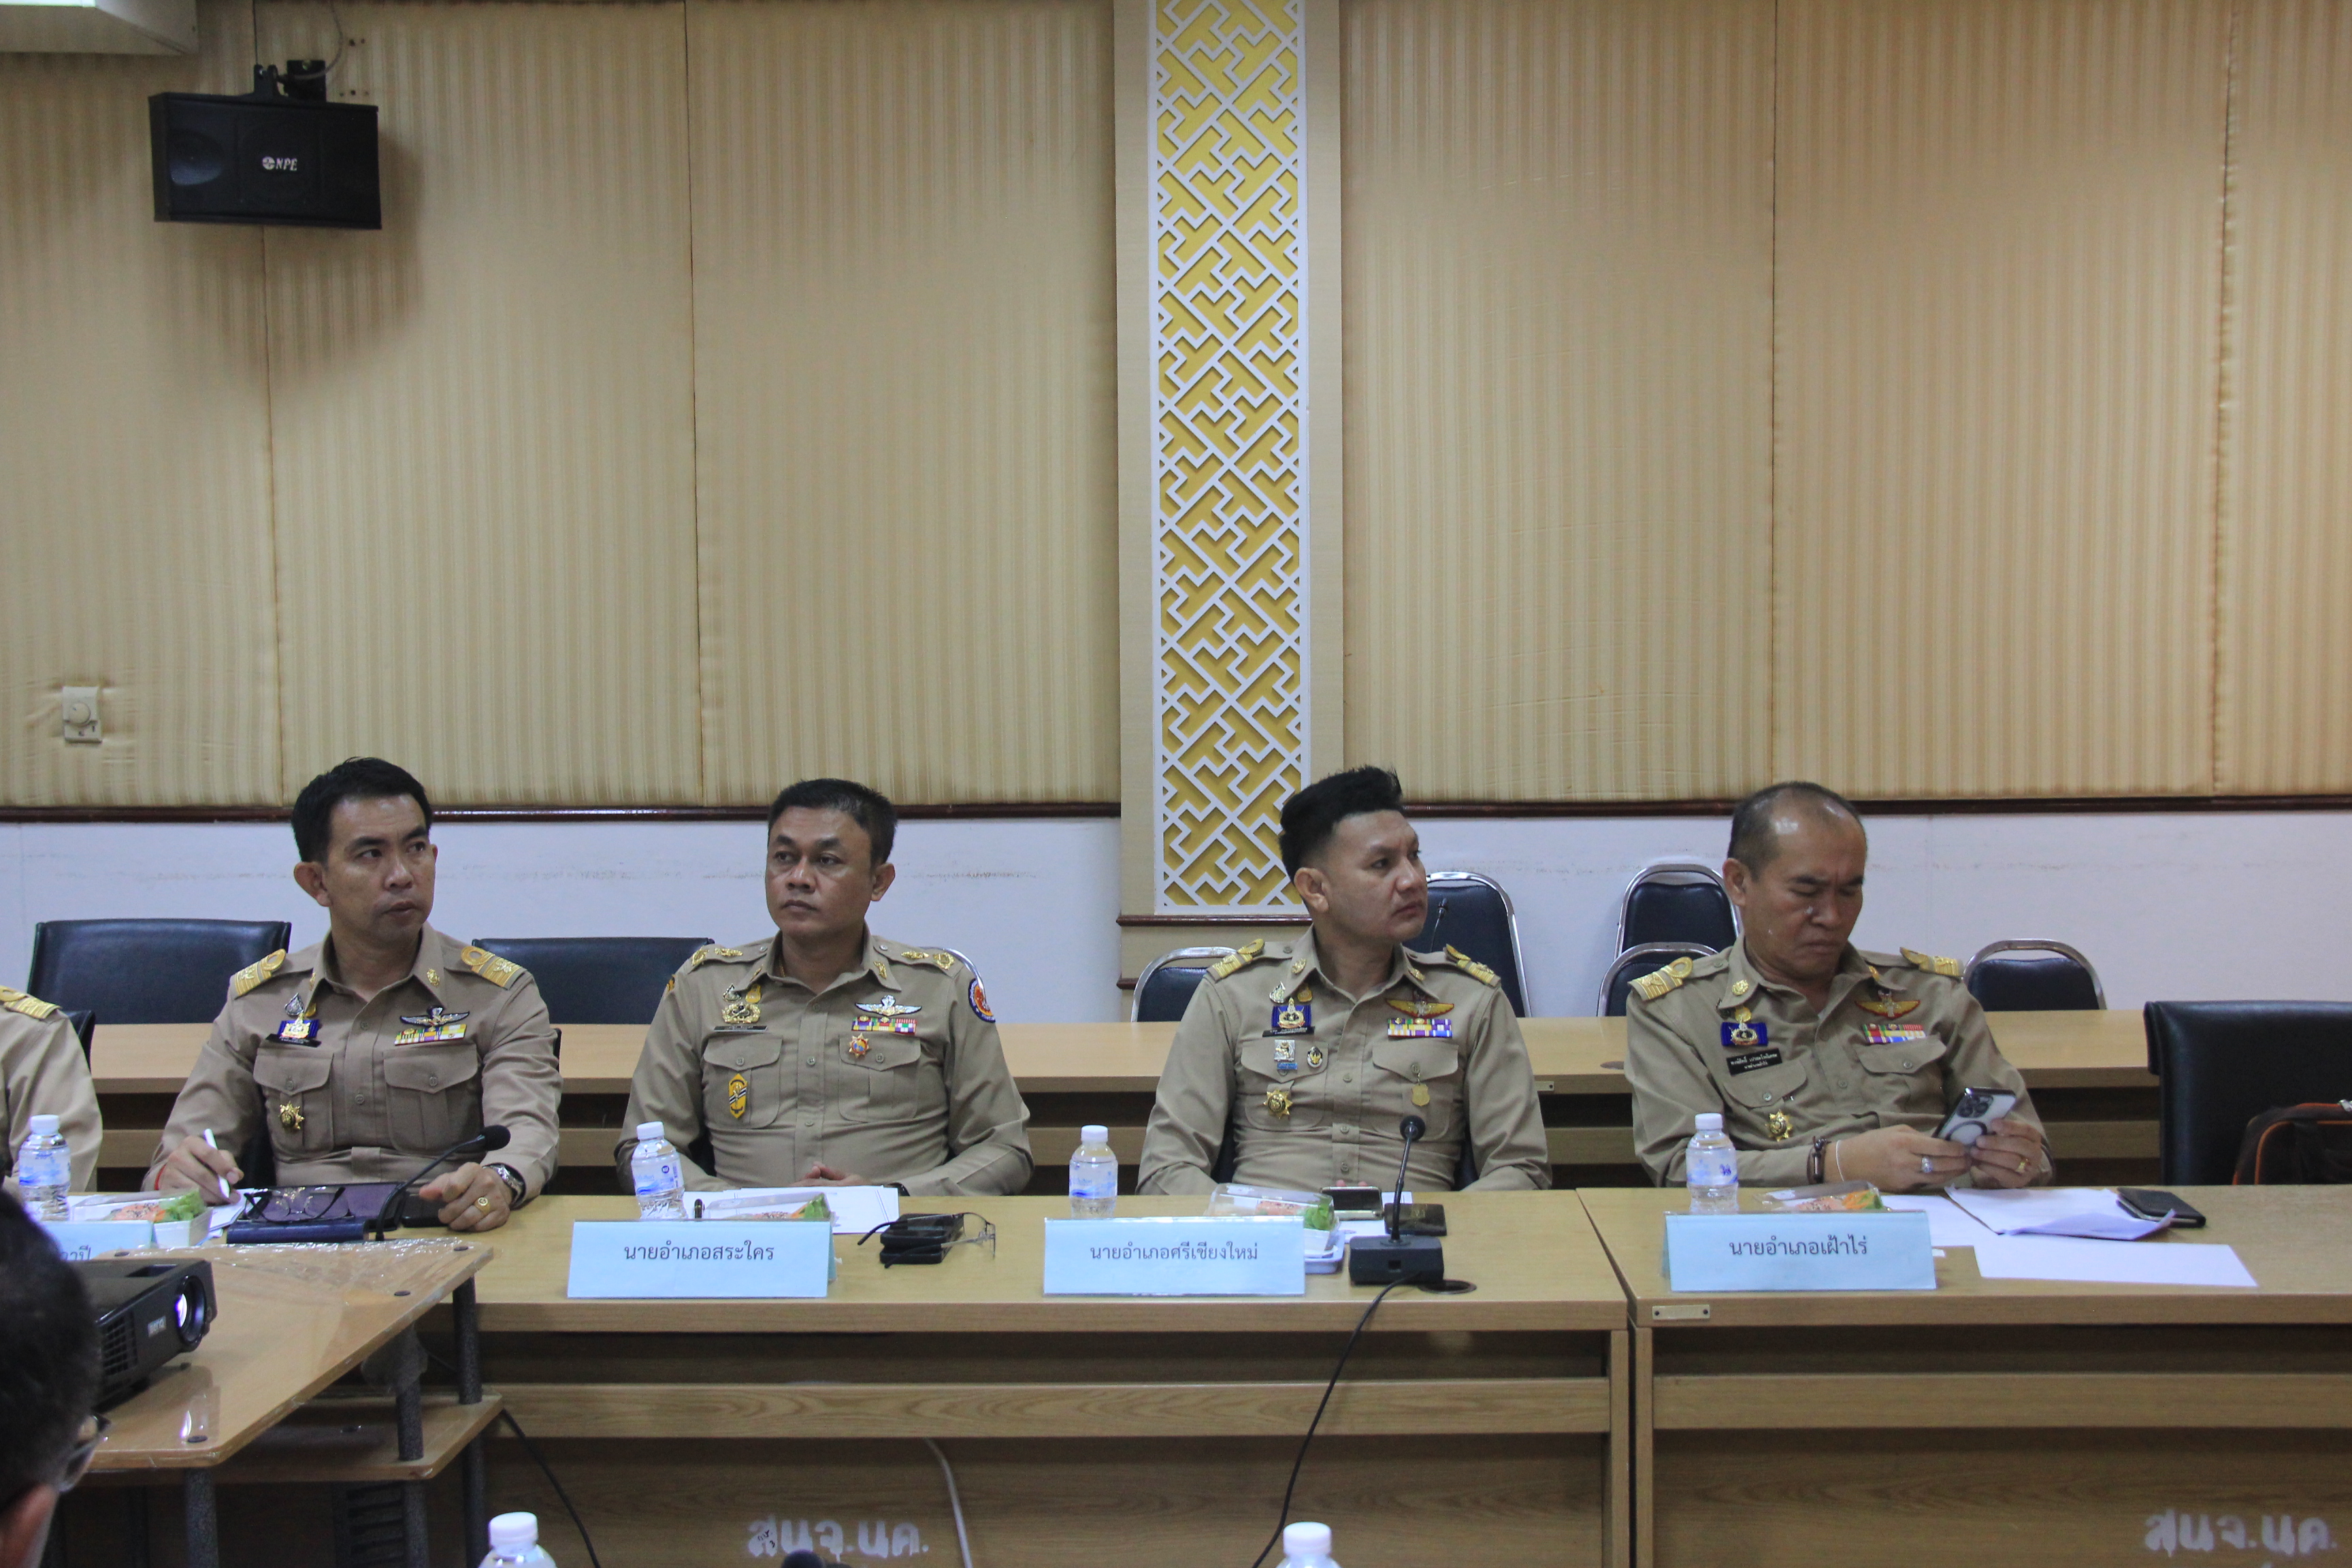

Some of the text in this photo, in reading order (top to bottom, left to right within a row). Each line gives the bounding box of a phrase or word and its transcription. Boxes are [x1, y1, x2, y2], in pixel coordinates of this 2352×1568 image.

[276, 157, 297, 171] NPE
[624, 1239, 774, 1260] นายอำเภอสระใคร
[1090, 1241, 1258, 1260] นายอำเภอศรีเชียงใหม่
[1729, 1234, 1867, 1255] นายอำเภอเฝ้าไร่
